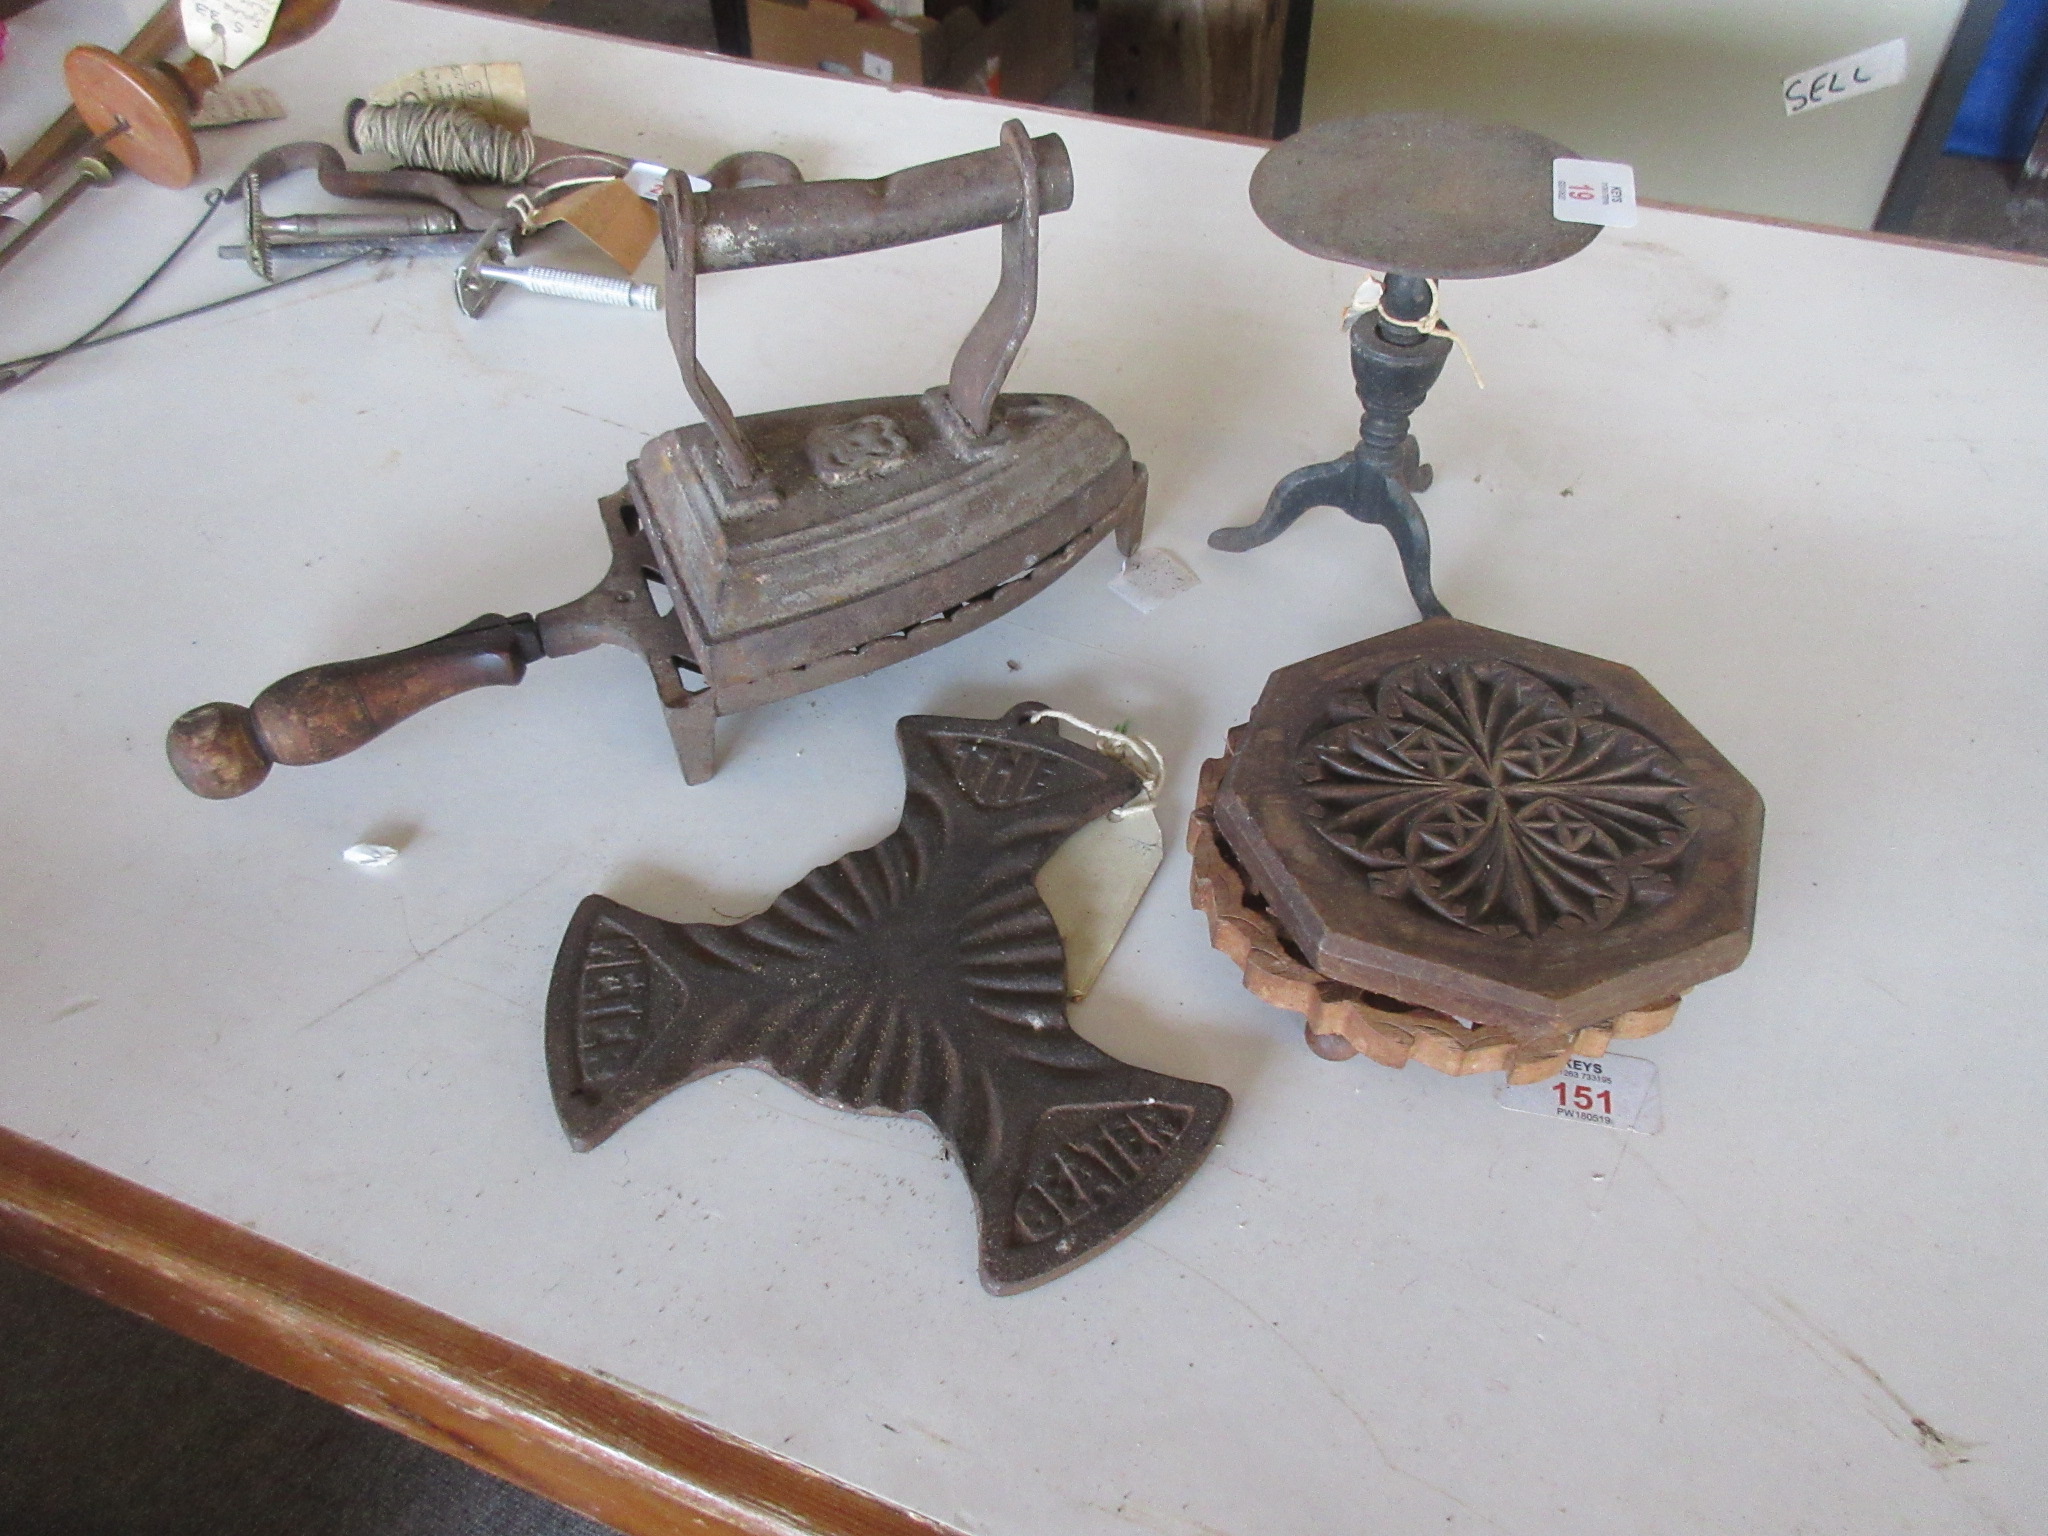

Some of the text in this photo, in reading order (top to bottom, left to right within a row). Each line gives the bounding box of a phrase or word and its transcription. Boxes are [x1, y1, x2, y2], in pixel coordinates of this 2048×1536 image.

[1786, 67, 1871, 111] SELL
[1552, 1081, 1612, 1115] 151
[1556, 1107, 1612, 1125] PW180519
